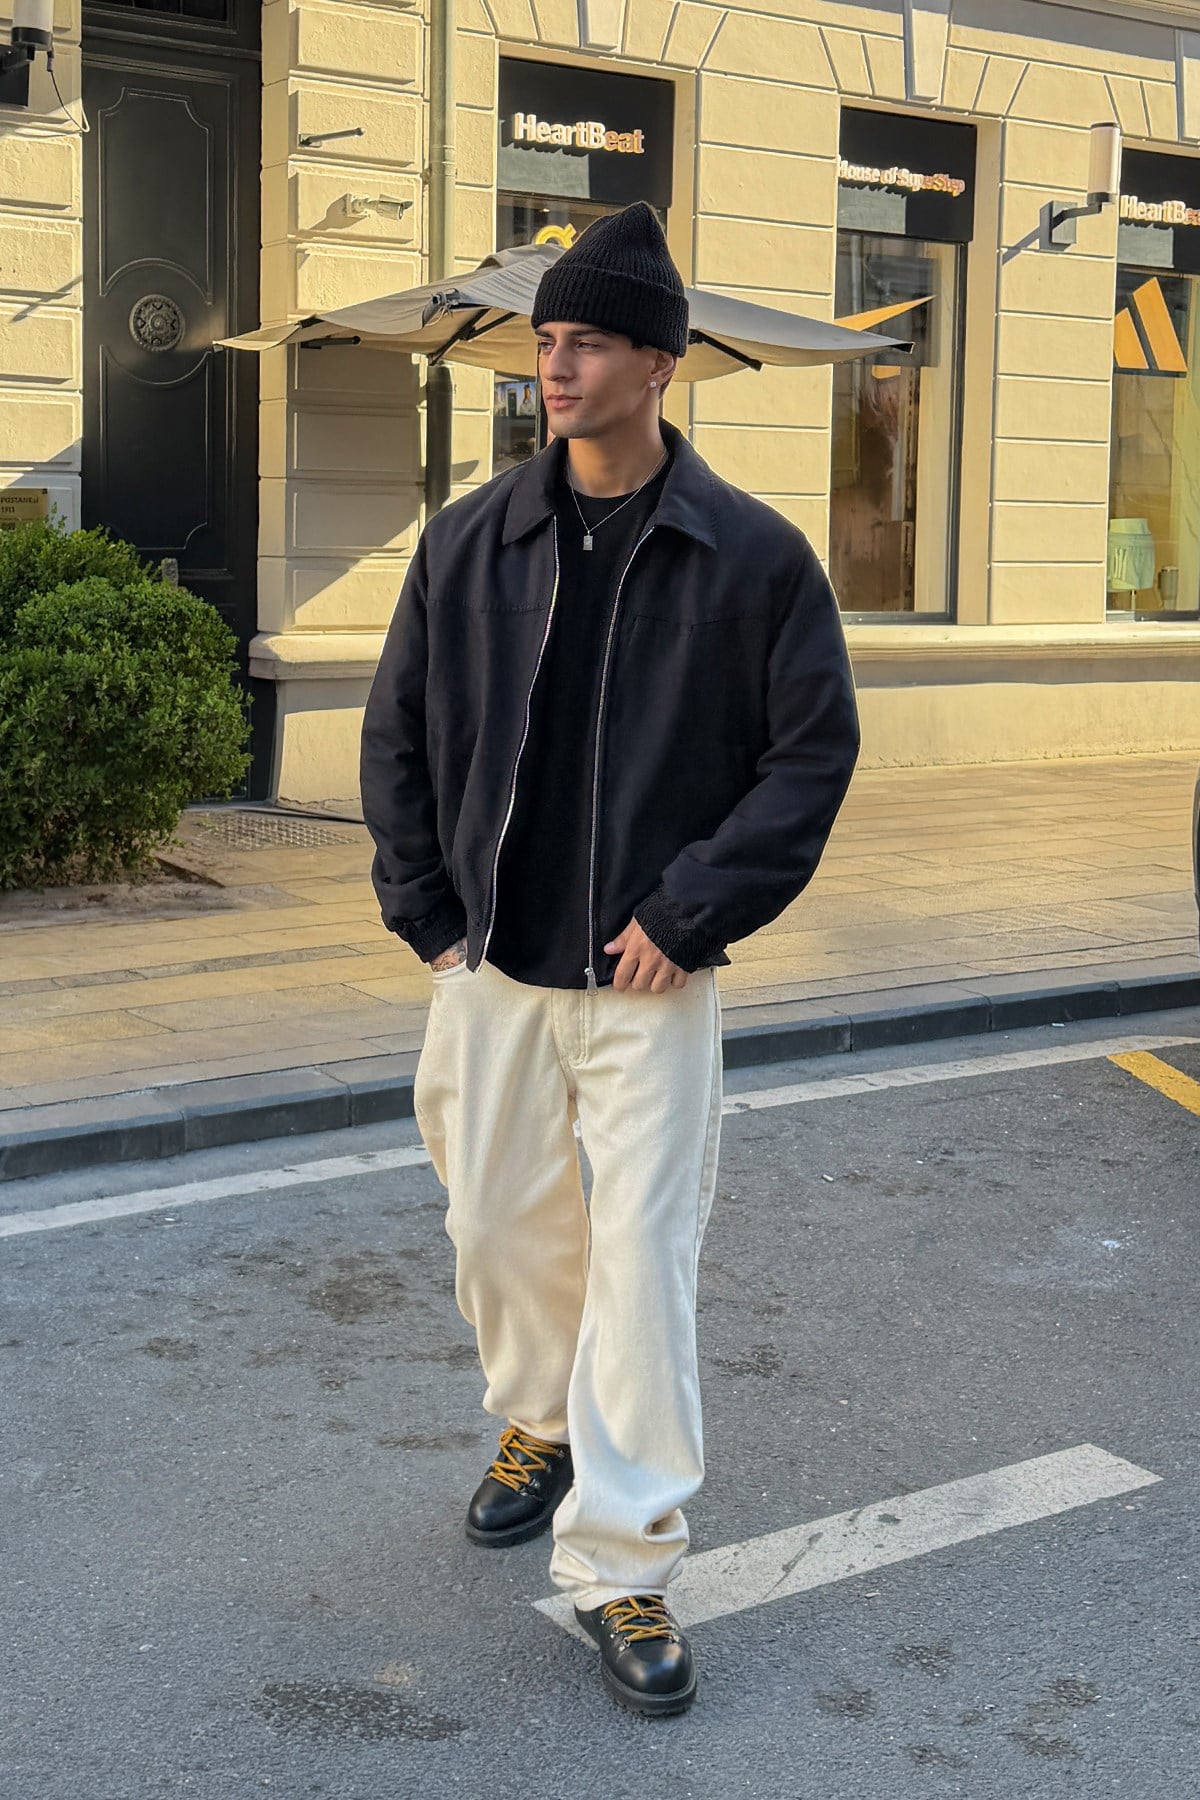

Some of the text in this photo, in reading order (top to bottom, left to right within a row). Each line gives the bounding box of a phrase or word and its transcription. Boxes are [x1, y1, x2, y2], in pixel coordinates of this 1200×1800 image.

[514, 112, 645, 154] HeartBeat
[838, 154, 966, 197] House of SuperStep
